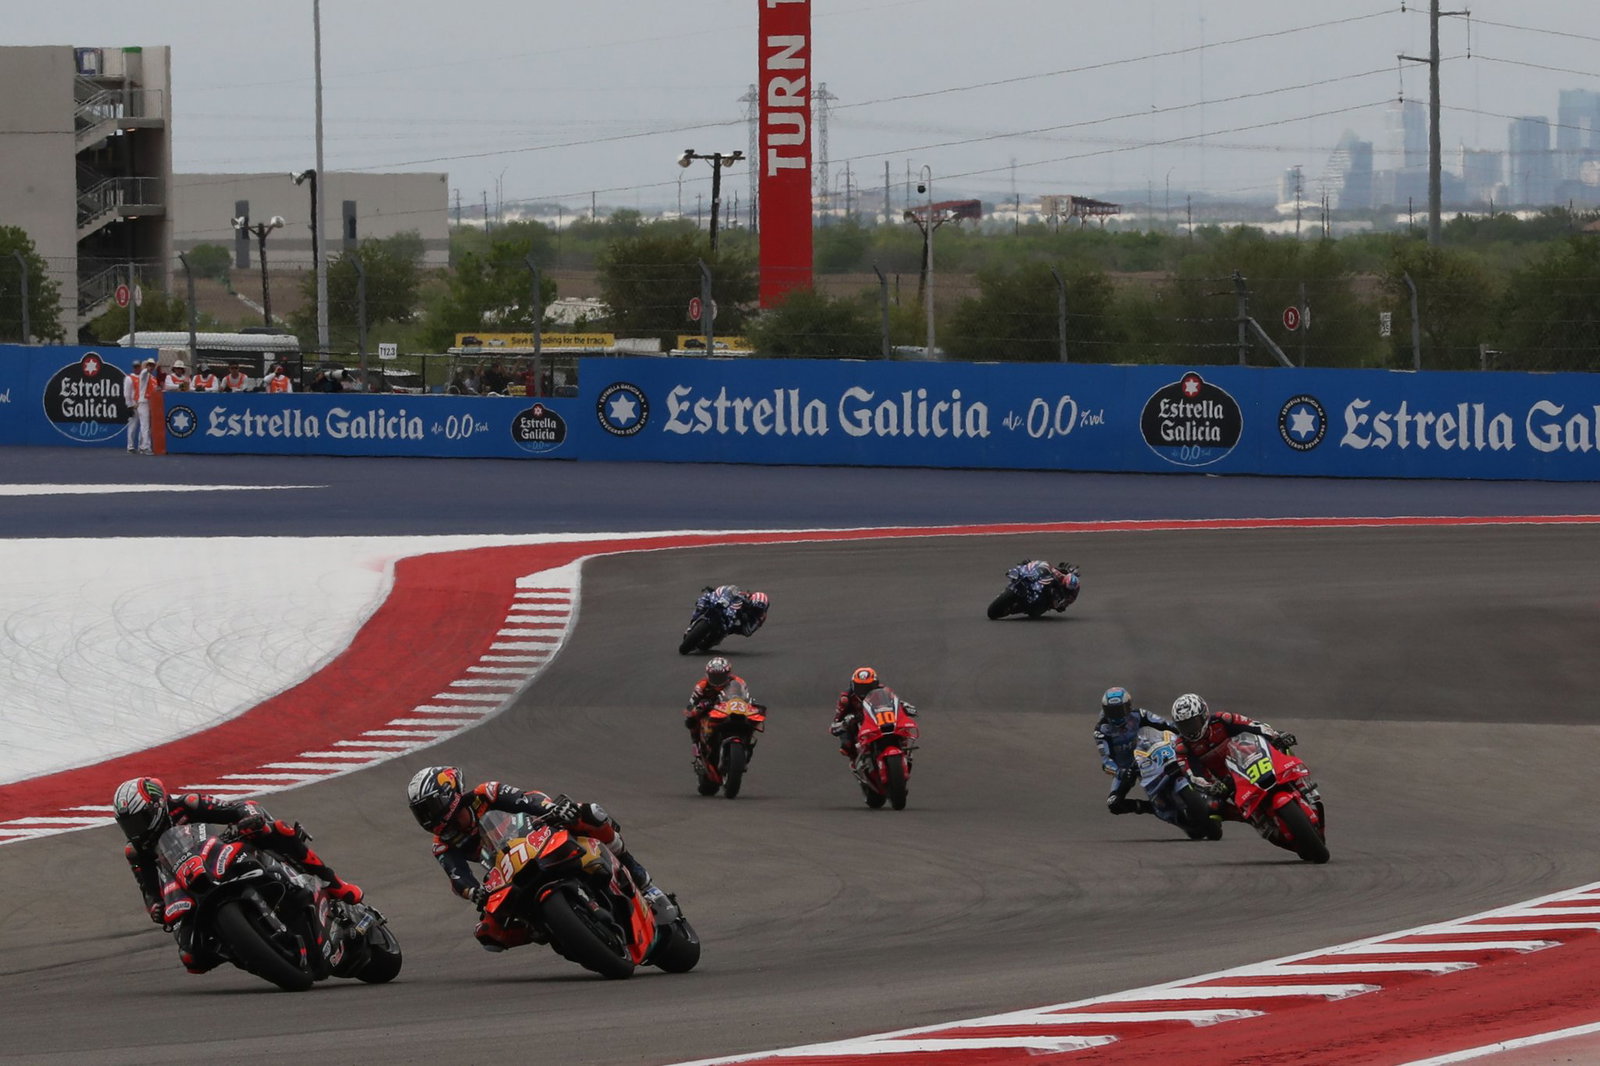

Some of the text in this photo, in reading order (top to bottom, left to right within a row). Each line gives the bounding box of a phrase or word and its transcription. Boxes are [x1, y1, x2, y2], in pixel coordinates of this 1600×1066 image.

[767, 35, 806, 177] TURN
[59, 376, 121, 398] Estrella
[61, 397, 118, 418] Galicia
[663, 384, 830, 436] Estrella
[838, 386, 992, 438] Galicia
[1027, 395, 1078, 439] 0,0
[1158, 398, 1224, 420] Estrella
[205, 406, 321, 438] Estrella
[325, 407, 425, 440] Galicia
[445, 413, 474, 439] 0,0
[519, 417, 557, 429] Estrella
[520, 428, 556, 440] Galicia
[1160, 419, 1221, 442] Galicia
[1340, 397, 1517, 452] Estrella
[730, 701, 746, 712] 23
[875, 711, 896, 726] 10
[1245, 757, 1273, 785] 36
[500, 843, 530, 883] 37
